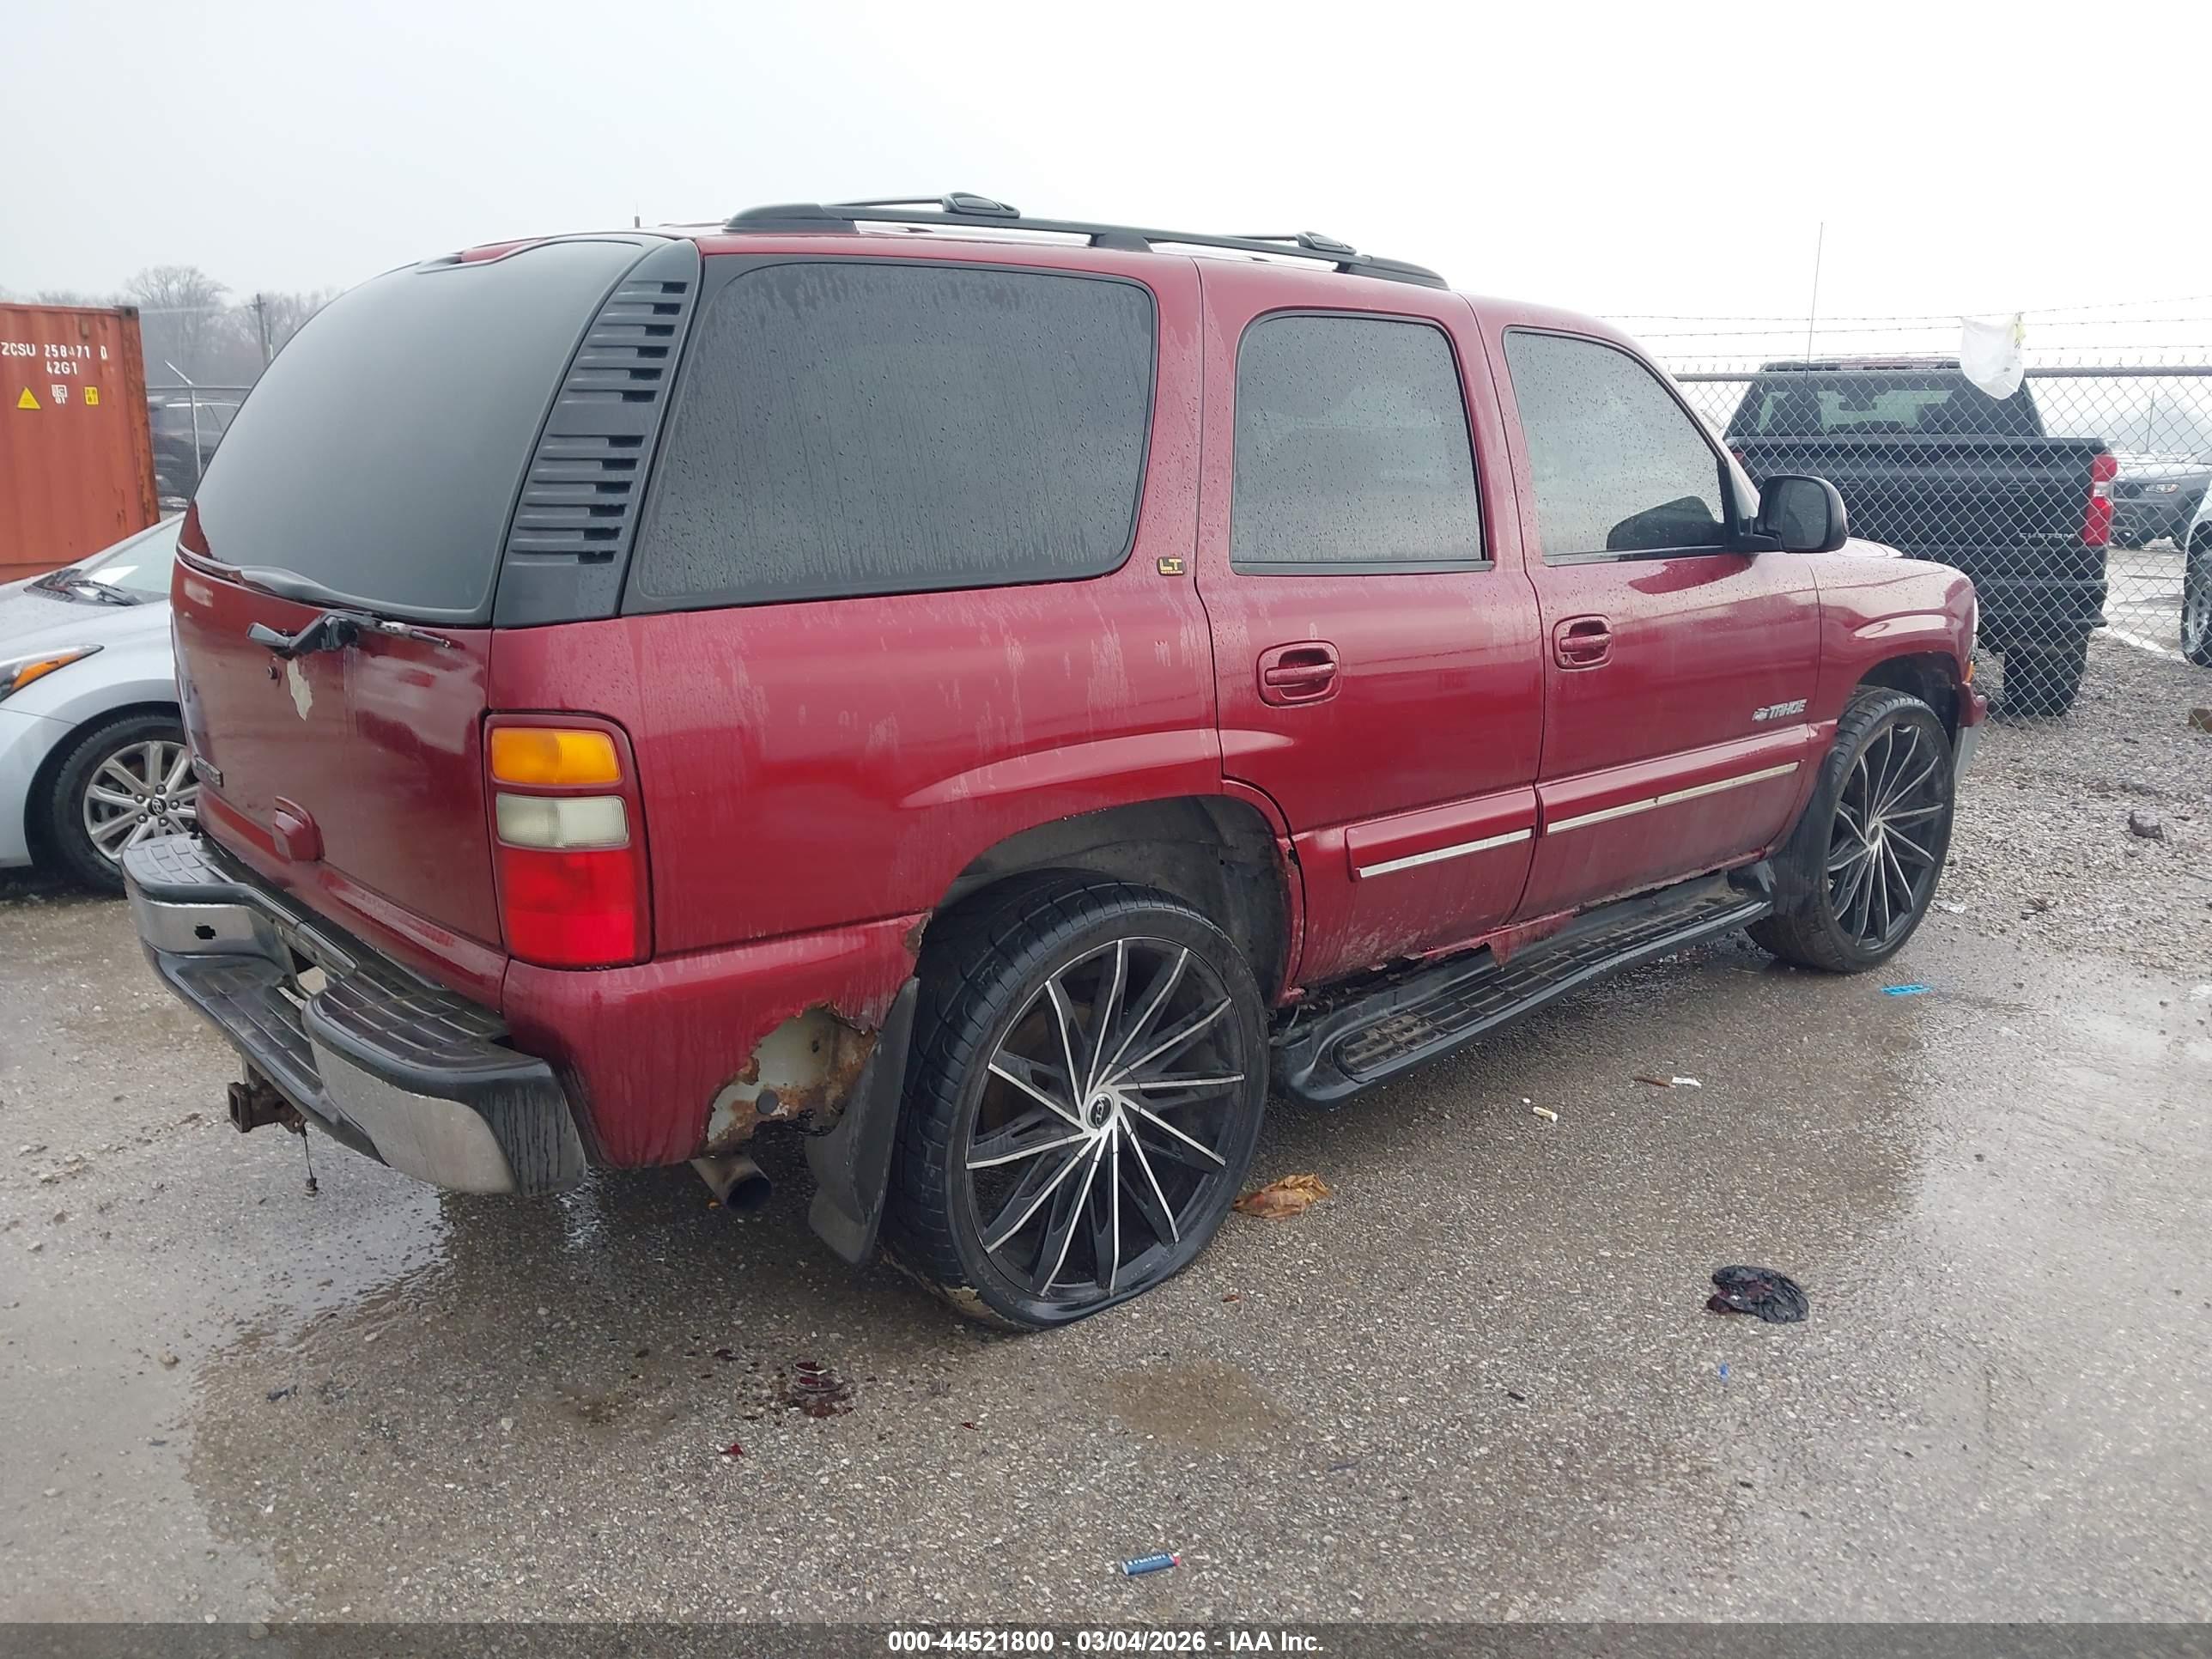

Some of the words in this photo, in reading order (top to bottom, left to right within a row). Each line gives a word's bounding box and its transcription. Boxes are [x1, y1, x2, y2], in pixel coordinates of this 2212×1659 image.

[1, 342, 36, 356] ZCSU
[46, 361, 77, 375] 42G1
[1159, 558, 1182, 571] LT
[1769, 698, 1808, 720] TAHOE
